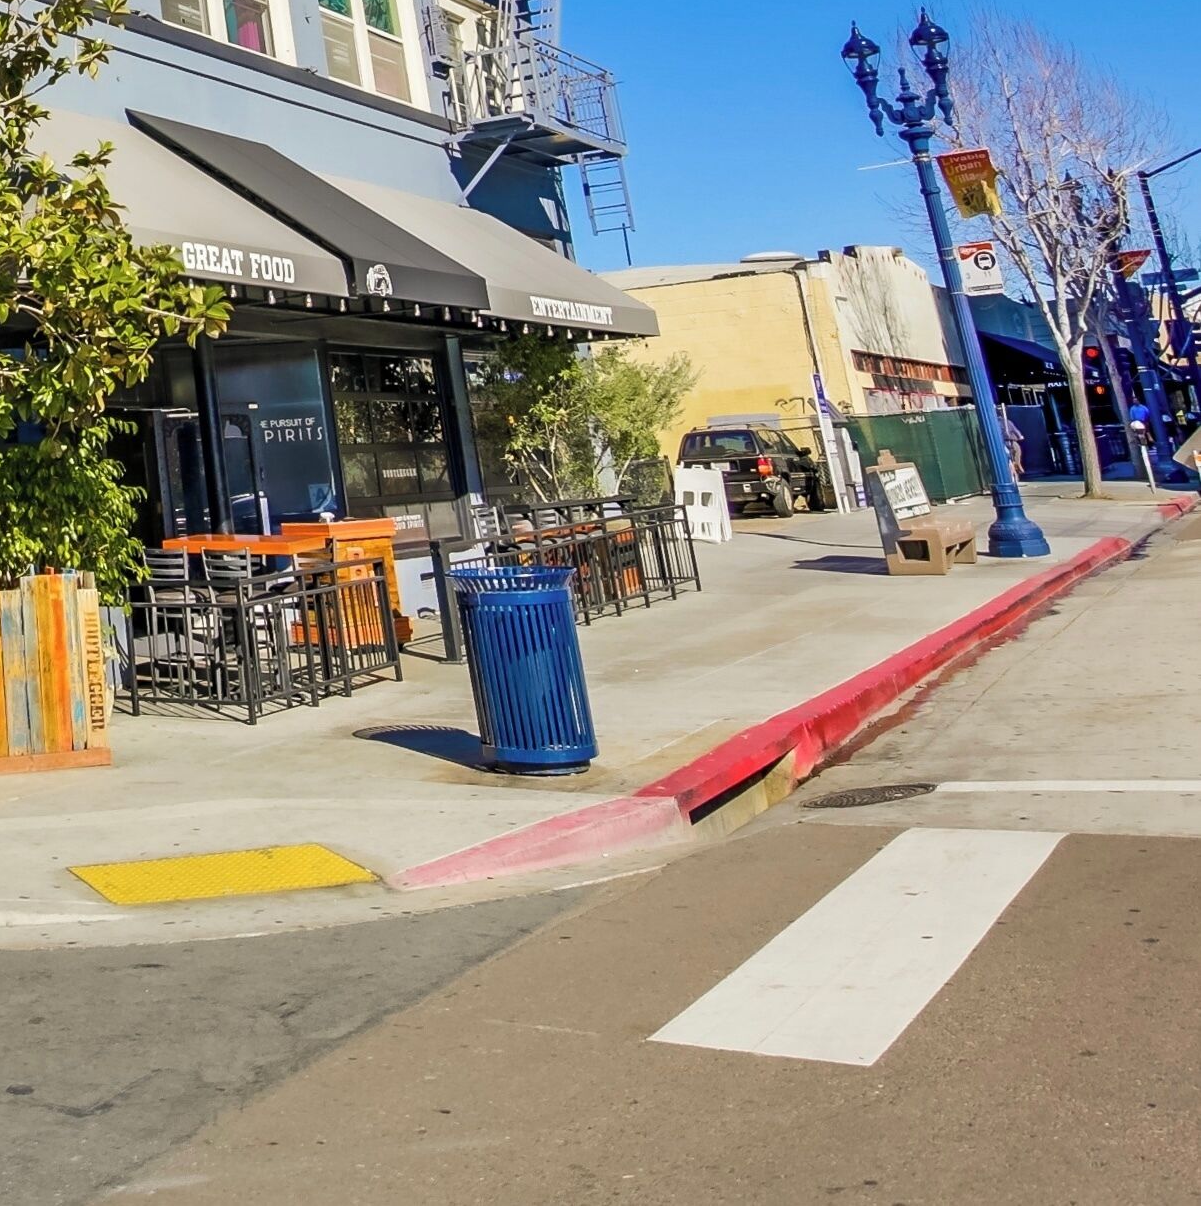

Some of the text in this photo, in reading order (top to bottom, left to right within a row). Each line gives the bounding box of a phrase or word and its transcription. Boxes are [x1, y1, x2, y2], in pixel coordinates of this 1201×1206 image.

[941, 153, 986, 166] Livable
[945, 161, 983, 176] Urban
[181, 241, 295, 284] GREAT FOOD
[529, 295, 613, 325] ENTERTAINMENT
[270, 418, 303, 429] PURSUIT
[305, 417, 317, 426] OF
[264, 426, 323, 444] PIRITS
[85, 611, 105, 733] BOOTLEGGER
